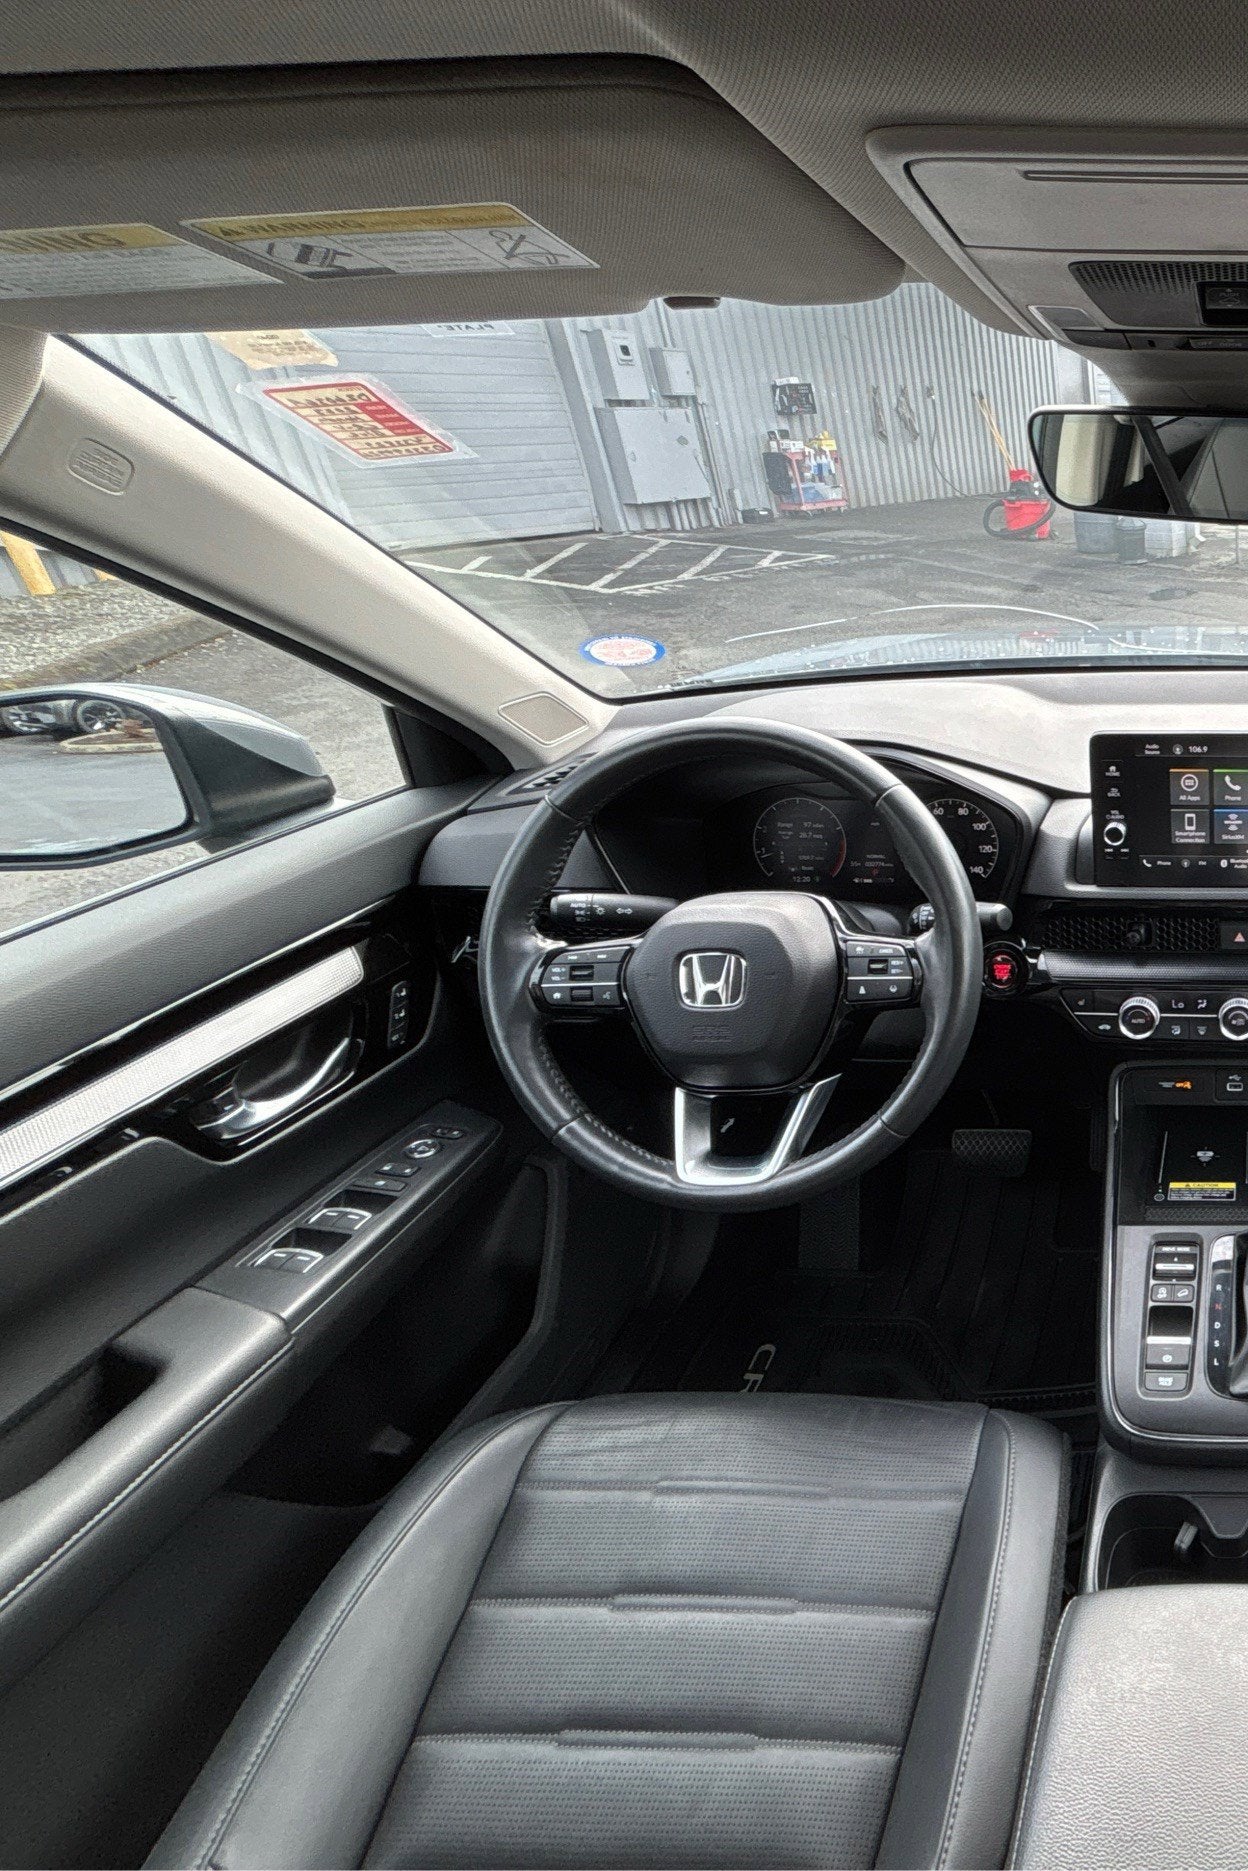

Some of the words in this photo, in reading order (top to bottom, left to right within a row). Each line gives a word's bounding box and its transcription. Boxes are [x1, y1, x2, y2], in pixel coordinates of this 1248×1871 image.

[242, 219, 366, 234] WARNING
[0, 233, 127, 252] NING
[1188, 745, 1208, 753] 106.9
[933, 807, 944, 815] 60
[958, 807, 969, 816] 80
[971, 823, 987, 831] 100
[978, 845, 993, 853] 120
[969, 865, 984, 874] 140
[1171, 999, 1185, 1009] Lo
[1216, 1284, 1222, 1292] R
[1213, 1358, 1220, 1366] L
